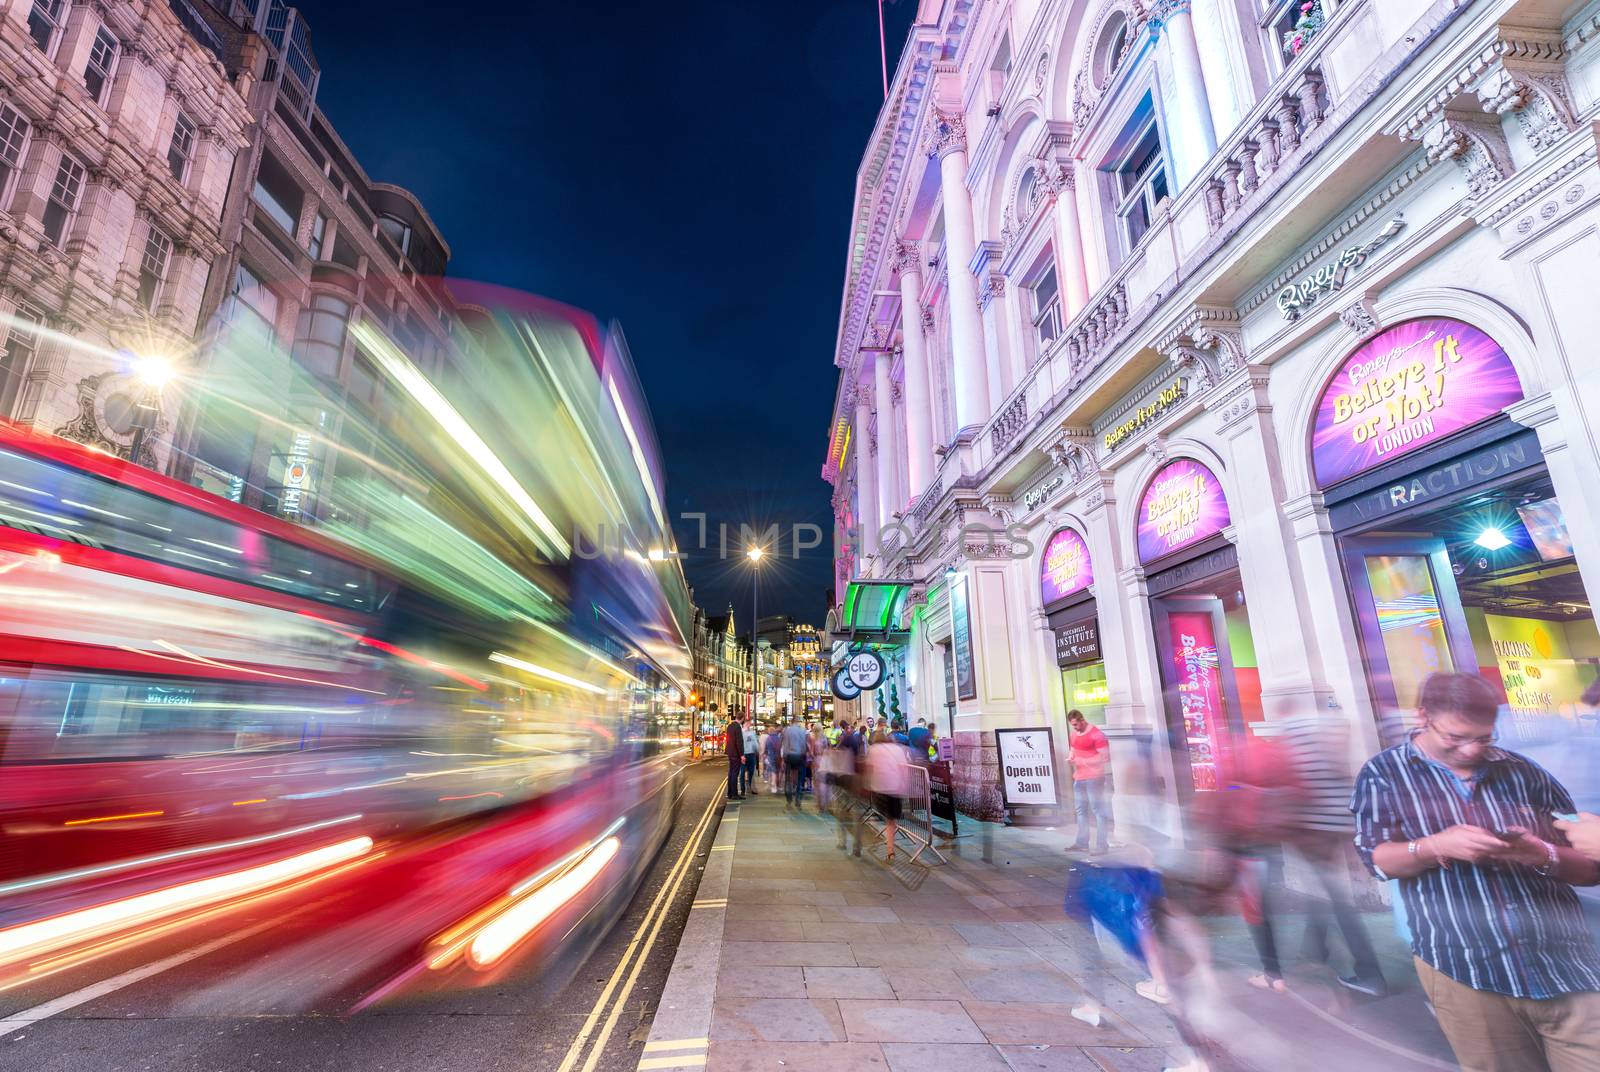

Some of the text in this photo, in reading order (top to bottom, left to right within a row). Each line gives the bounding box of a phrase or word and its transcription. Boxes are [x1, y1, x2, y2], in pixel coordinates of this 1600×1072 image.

[1333, 335, 1463, 425] Believe It
[1104, 377, 1181, 449] Believe It or Not!
[1353, 374, 1444, 444] or Not!
[1375, 416, 1435, 456] LONDON
[1147, 473, 1207, 521] Believe It
[1156, 521, 1171, 537] or
[1168, 526, 1195, 547] LONDON
[1057, 629, 1095, 648] INSTITUTE
[1082, 643, 1096, 654] CLUBS
[851, 659, 878, 672] club
[1006, 765, 1051, 778] Open till
[1017, 781, 1042, 793] 3am
